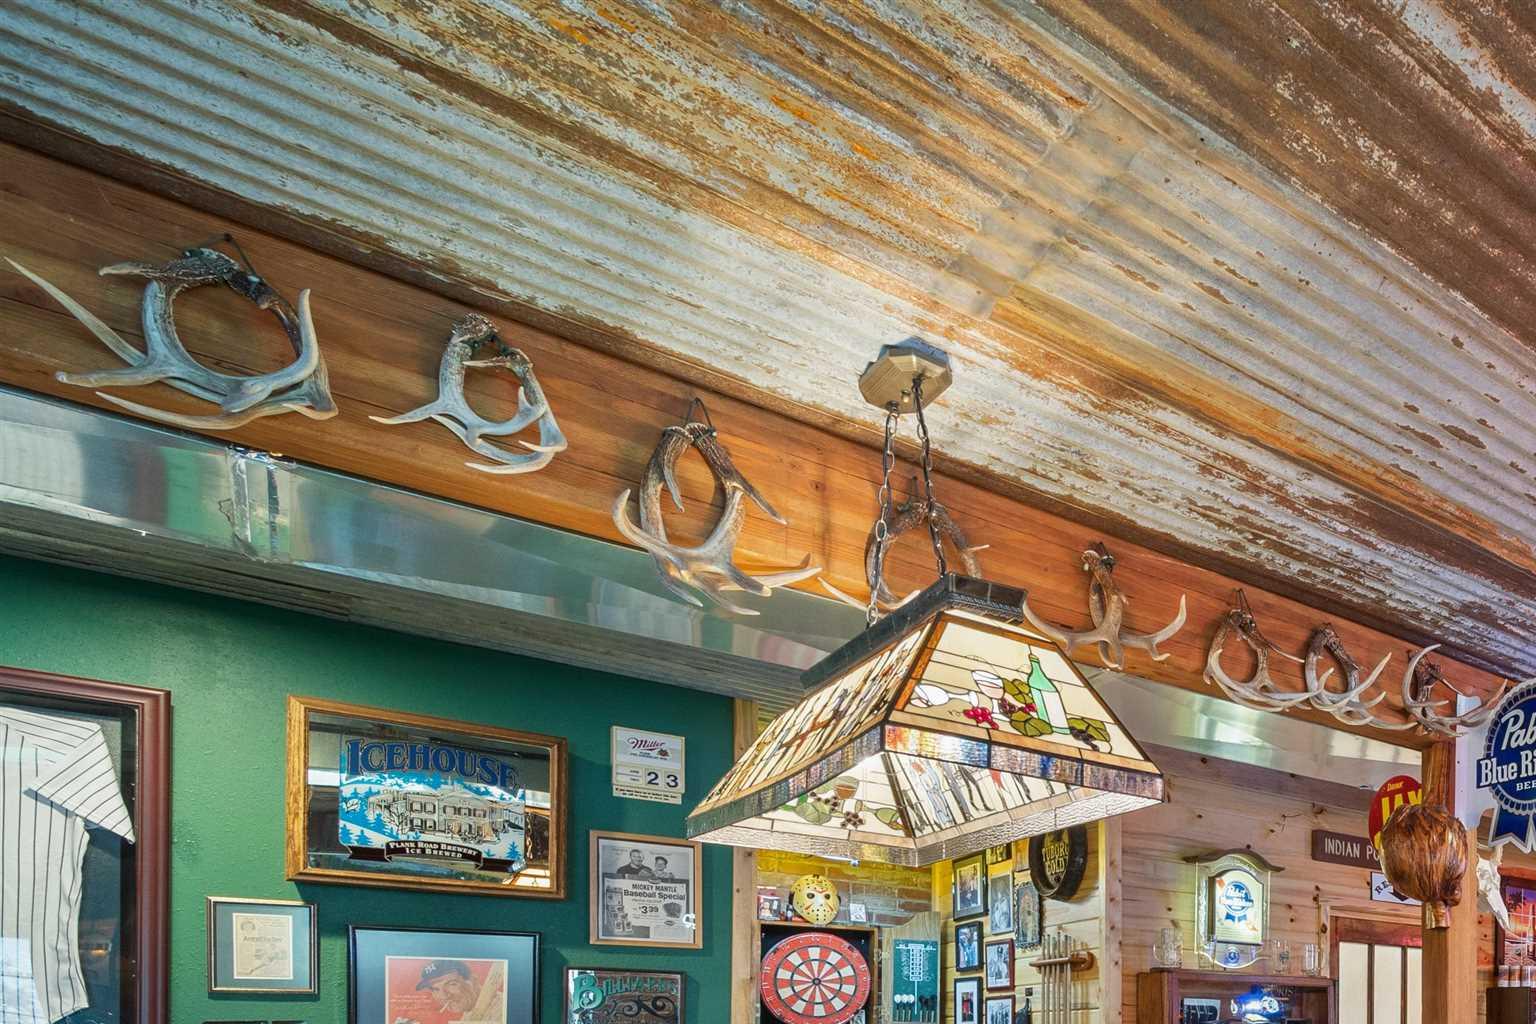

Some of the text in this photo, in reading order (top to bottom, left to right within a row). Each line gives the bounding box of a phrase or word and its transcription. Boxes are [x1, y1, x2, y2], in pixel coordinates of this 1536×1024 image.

[626, 736, 667, 751] Miller
[346, 738, 521, 792] ICEHOUSE
[1479, 756, 1518, 787] Blue
[389, 840, 478, 856] PLANK ROAD BREWERY
[405, 847, 463, 859] ICE BREWED
[1324, 837, 1360, 858] INDIAN
[624, 889, 657, 898] Baseball
[658, 892, 686, 901] Special
[632, 883, 678, 893] MICKEY MANTLE
